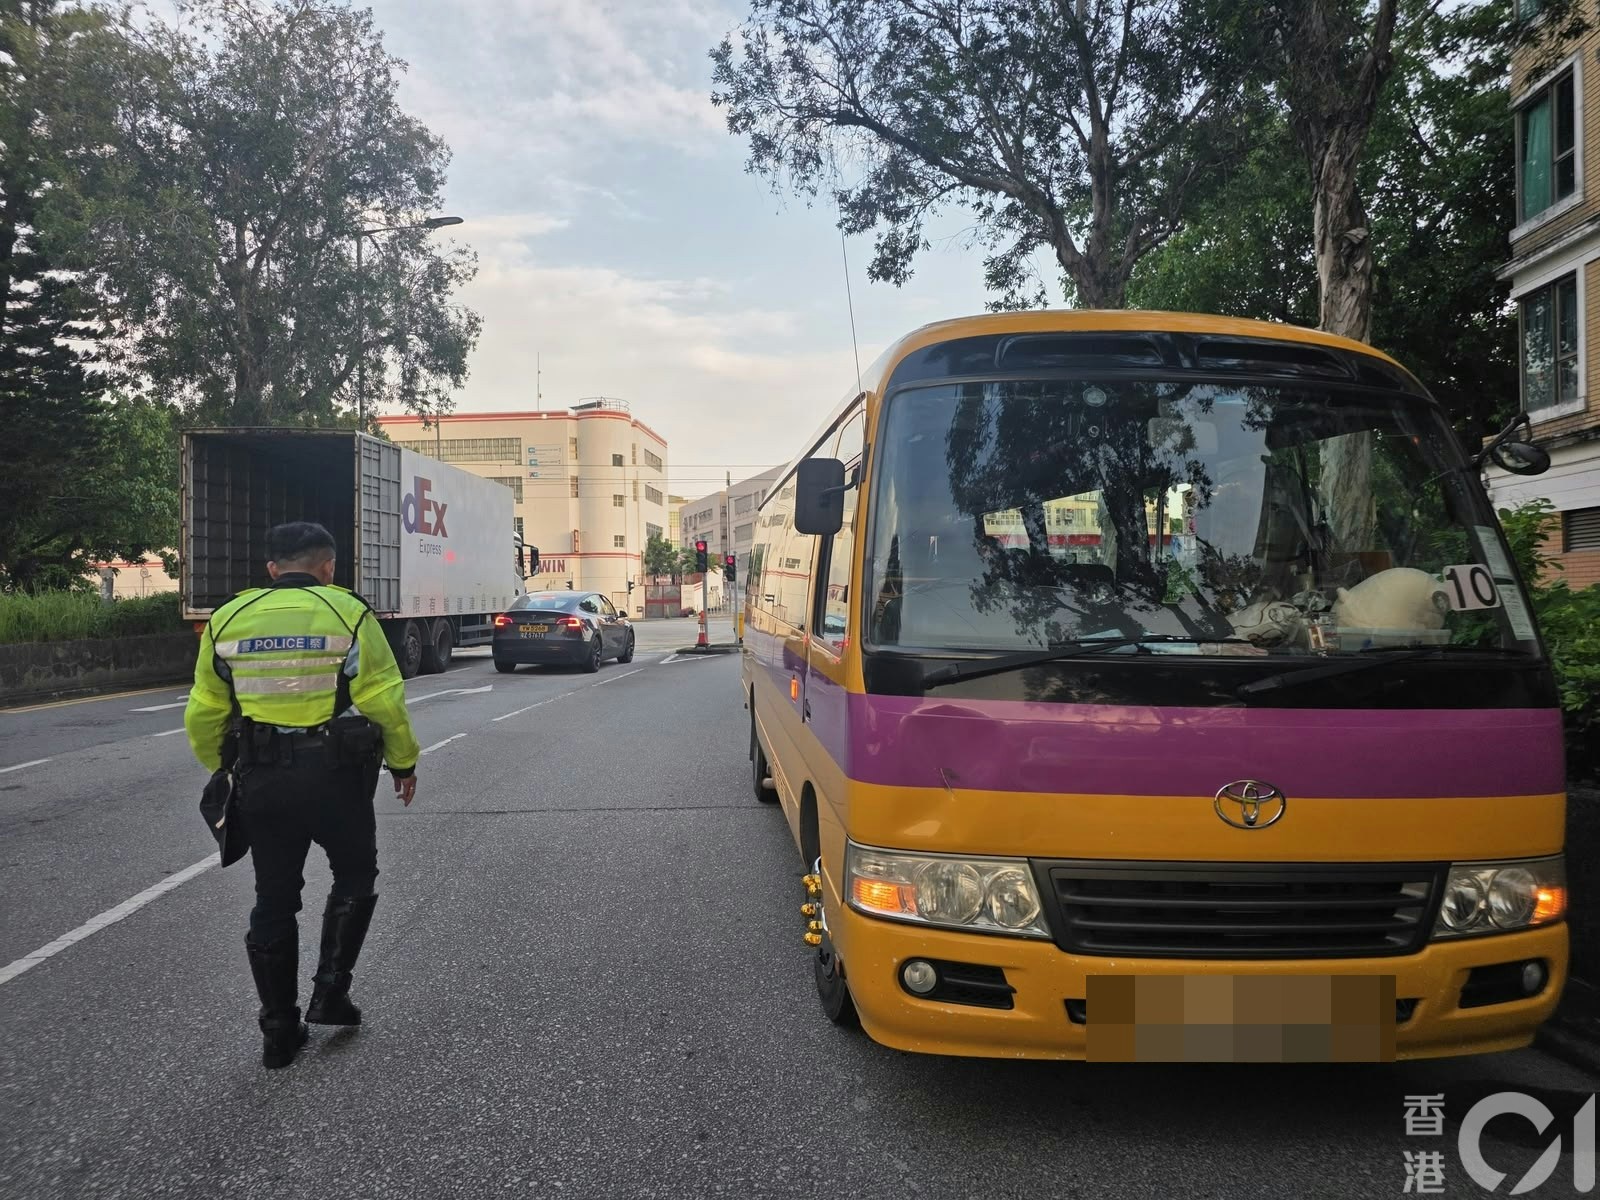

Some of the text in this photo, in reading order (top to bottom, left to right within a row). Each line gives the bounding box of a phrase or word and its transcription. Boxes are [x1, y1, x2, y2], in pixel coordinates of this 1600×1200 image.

[401, 475, 449, 539] dEx
[419, 538, 442, 557] Express
[523, 559, 566, 573] WIN
[1445, 566, 1497, 609] 10
[255, 638, 304, 650] POLICE
